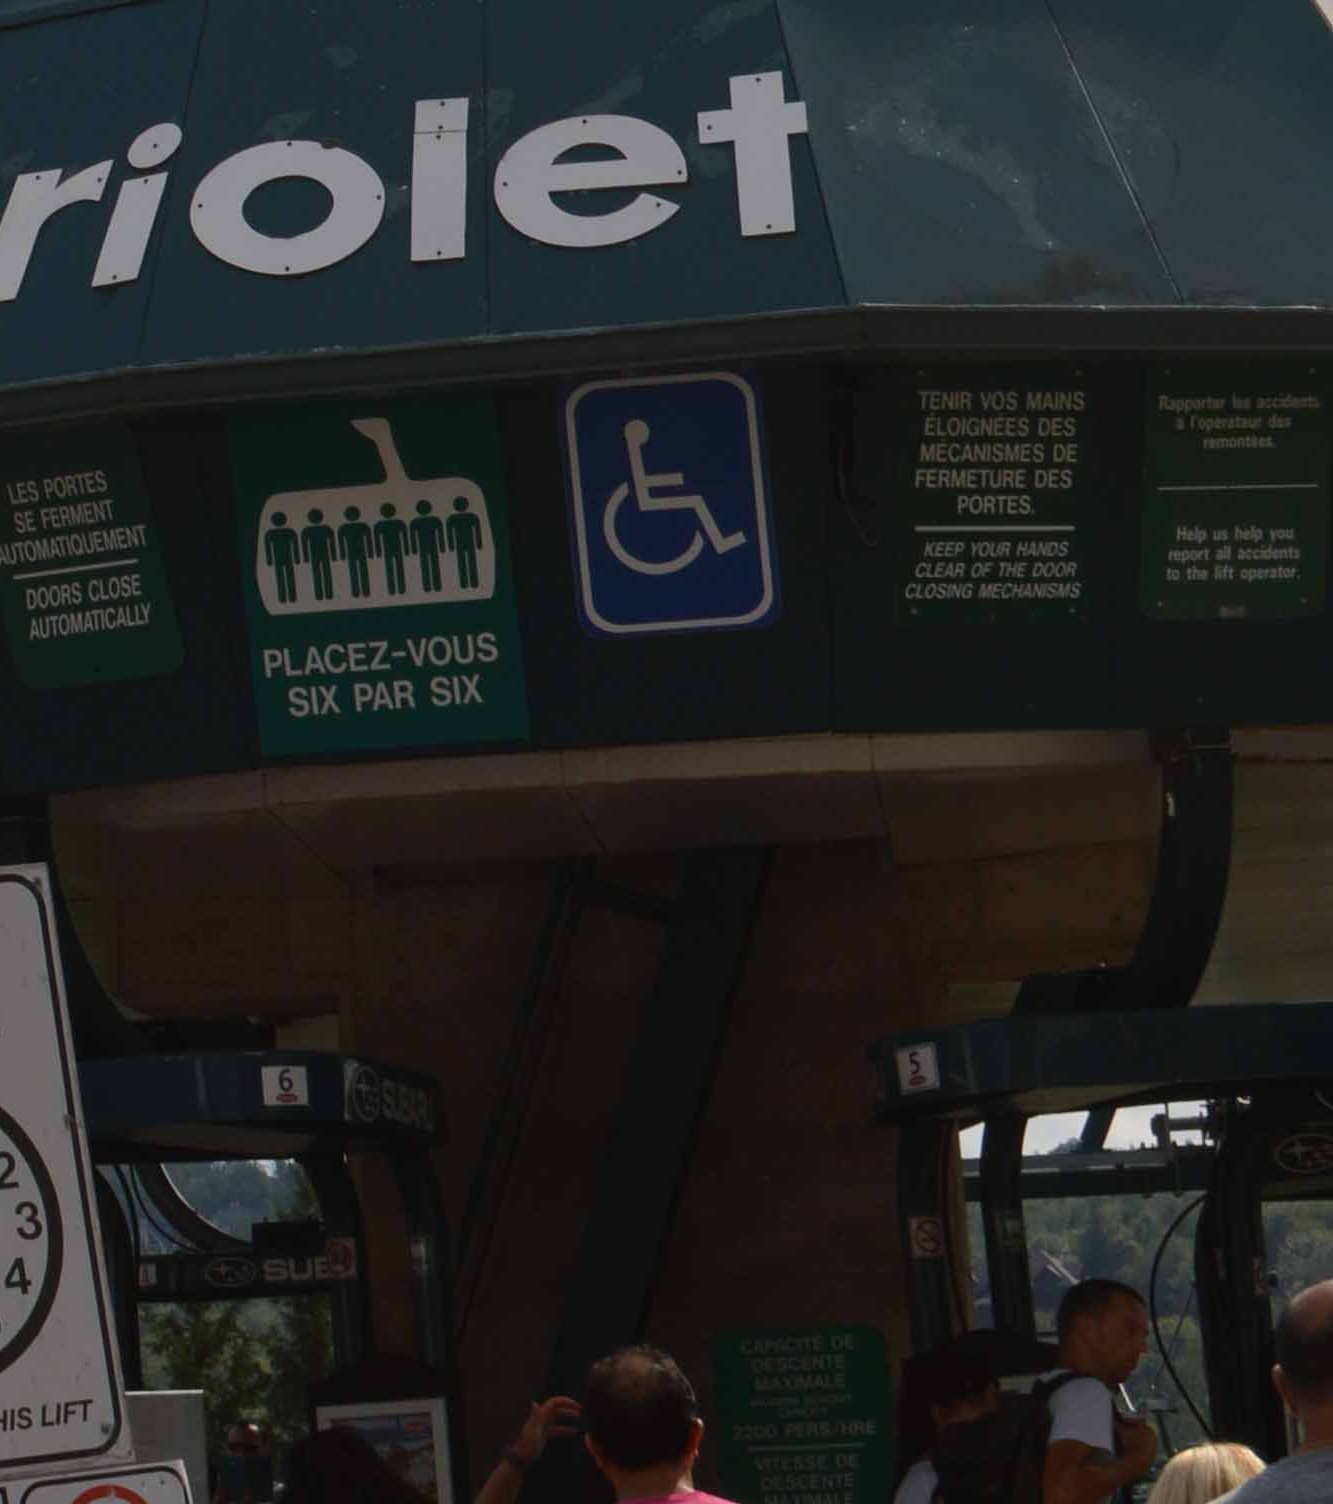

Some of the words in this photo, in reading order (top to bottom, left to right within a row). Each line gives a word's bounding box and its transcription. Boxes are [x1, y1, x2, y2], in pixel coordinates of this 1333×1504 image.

[918, 391, 972, 412] TENIR
[980, 390, 1019, 411] VOS
[1026, 389, 1085, 411] MAINS
[1253, 394, 1321, 409] accidents
[924, 412, 1030, 438] ÉLOIGNÉES
[1037, 416, 1076, 438] DES
[920, 439, 1044, 463] MÉCANISMES
[1053, 443, 1077, 463] DE
[7, 479, 39, 505] LES
[44, 469, 109, 500] PORTES
[914, 469, 1027, 489] FERMETURE
[1034, 468, 1072, 488] DES
[14, 511, 36, 534] SE
[41, 499, 116, 530] FERMENT
[957, 495, 1036, 515] PORTES.
[1176, 526, 1207, 544] Help
[1212, 528, 1229, 541] us
[1235, 525, 1263, 543] help
[1269, 527, 1294, 542] you
[924, 541, 965, 558] KEEP
[970, 541, 1012, 558] YOUR
[1016, 540, 1069, 558] HANDS
[1168, 548, 1210, 563] report
[1215, 545, 1232, 560] all
[1237, 545, 1301, 560] accidents
[914, 562, 966, 578] CLEAR
[971, 562, 994, 578] OF
[998, 562, 1028, 578] THE
[1031, 561, 1078, 578] DOOR
[1166, 567, 1180, 581] to
[1187, 566, 1208, 581] the
[1214, 564, 1234, 581] lift
[1240, 566, 1301, 582] operator.
[25, 584, 83, 611] DOORS
[88, 574, 142, 602] CLOSE
[905, 583, 973, 600] CLOSING
[977, 582, 1082, 599] MECHANISMS
[29, 602, 152, 641] AUTOMATICALLY
[262, 632, 499, 680] PLACEZ-VOUS
[288, 684, 341, 719] SIX
[353, 679, 416, 713] PAR
[430, 673, 485, 707] SIX
[909, 1052, 921, 1074] 5
[278, 1069, 293, 1092] 6
[15, 1202, 43, 1240] 3
[4, 1257, 32, 1296] 4
[830, 1335, 854, 1351] DE
[41, 1399, 94, 1426] LIFT
[836, 1454, 860, 1469] DE
